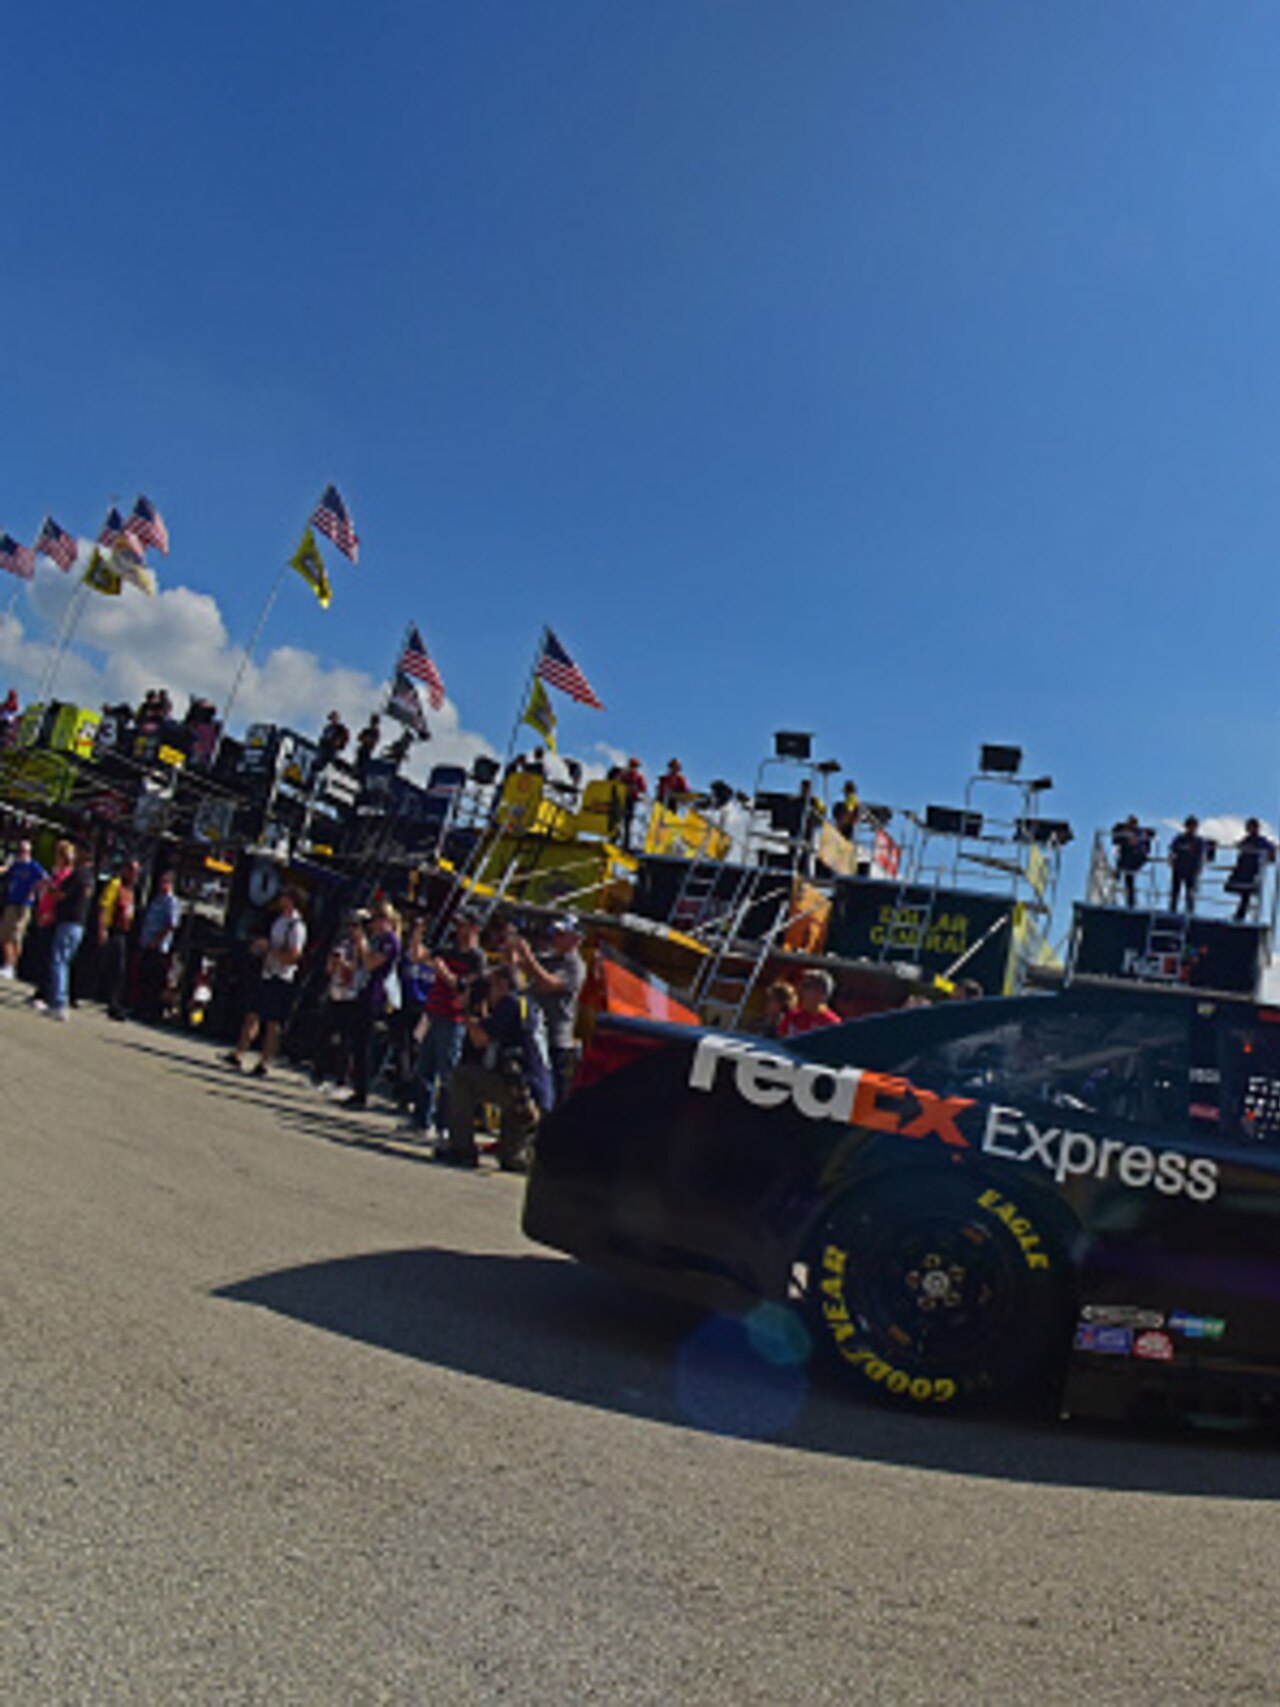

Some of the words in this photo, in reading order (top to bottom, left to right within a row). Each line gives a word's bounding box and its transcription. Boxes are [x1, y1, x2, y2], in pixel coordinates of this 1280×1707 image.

[981, 1103, 1218, 1201] Express
[976, 1189, 1049, 1270] EAGLE
[821, 1245, 957, 1401] GOODYEAR
